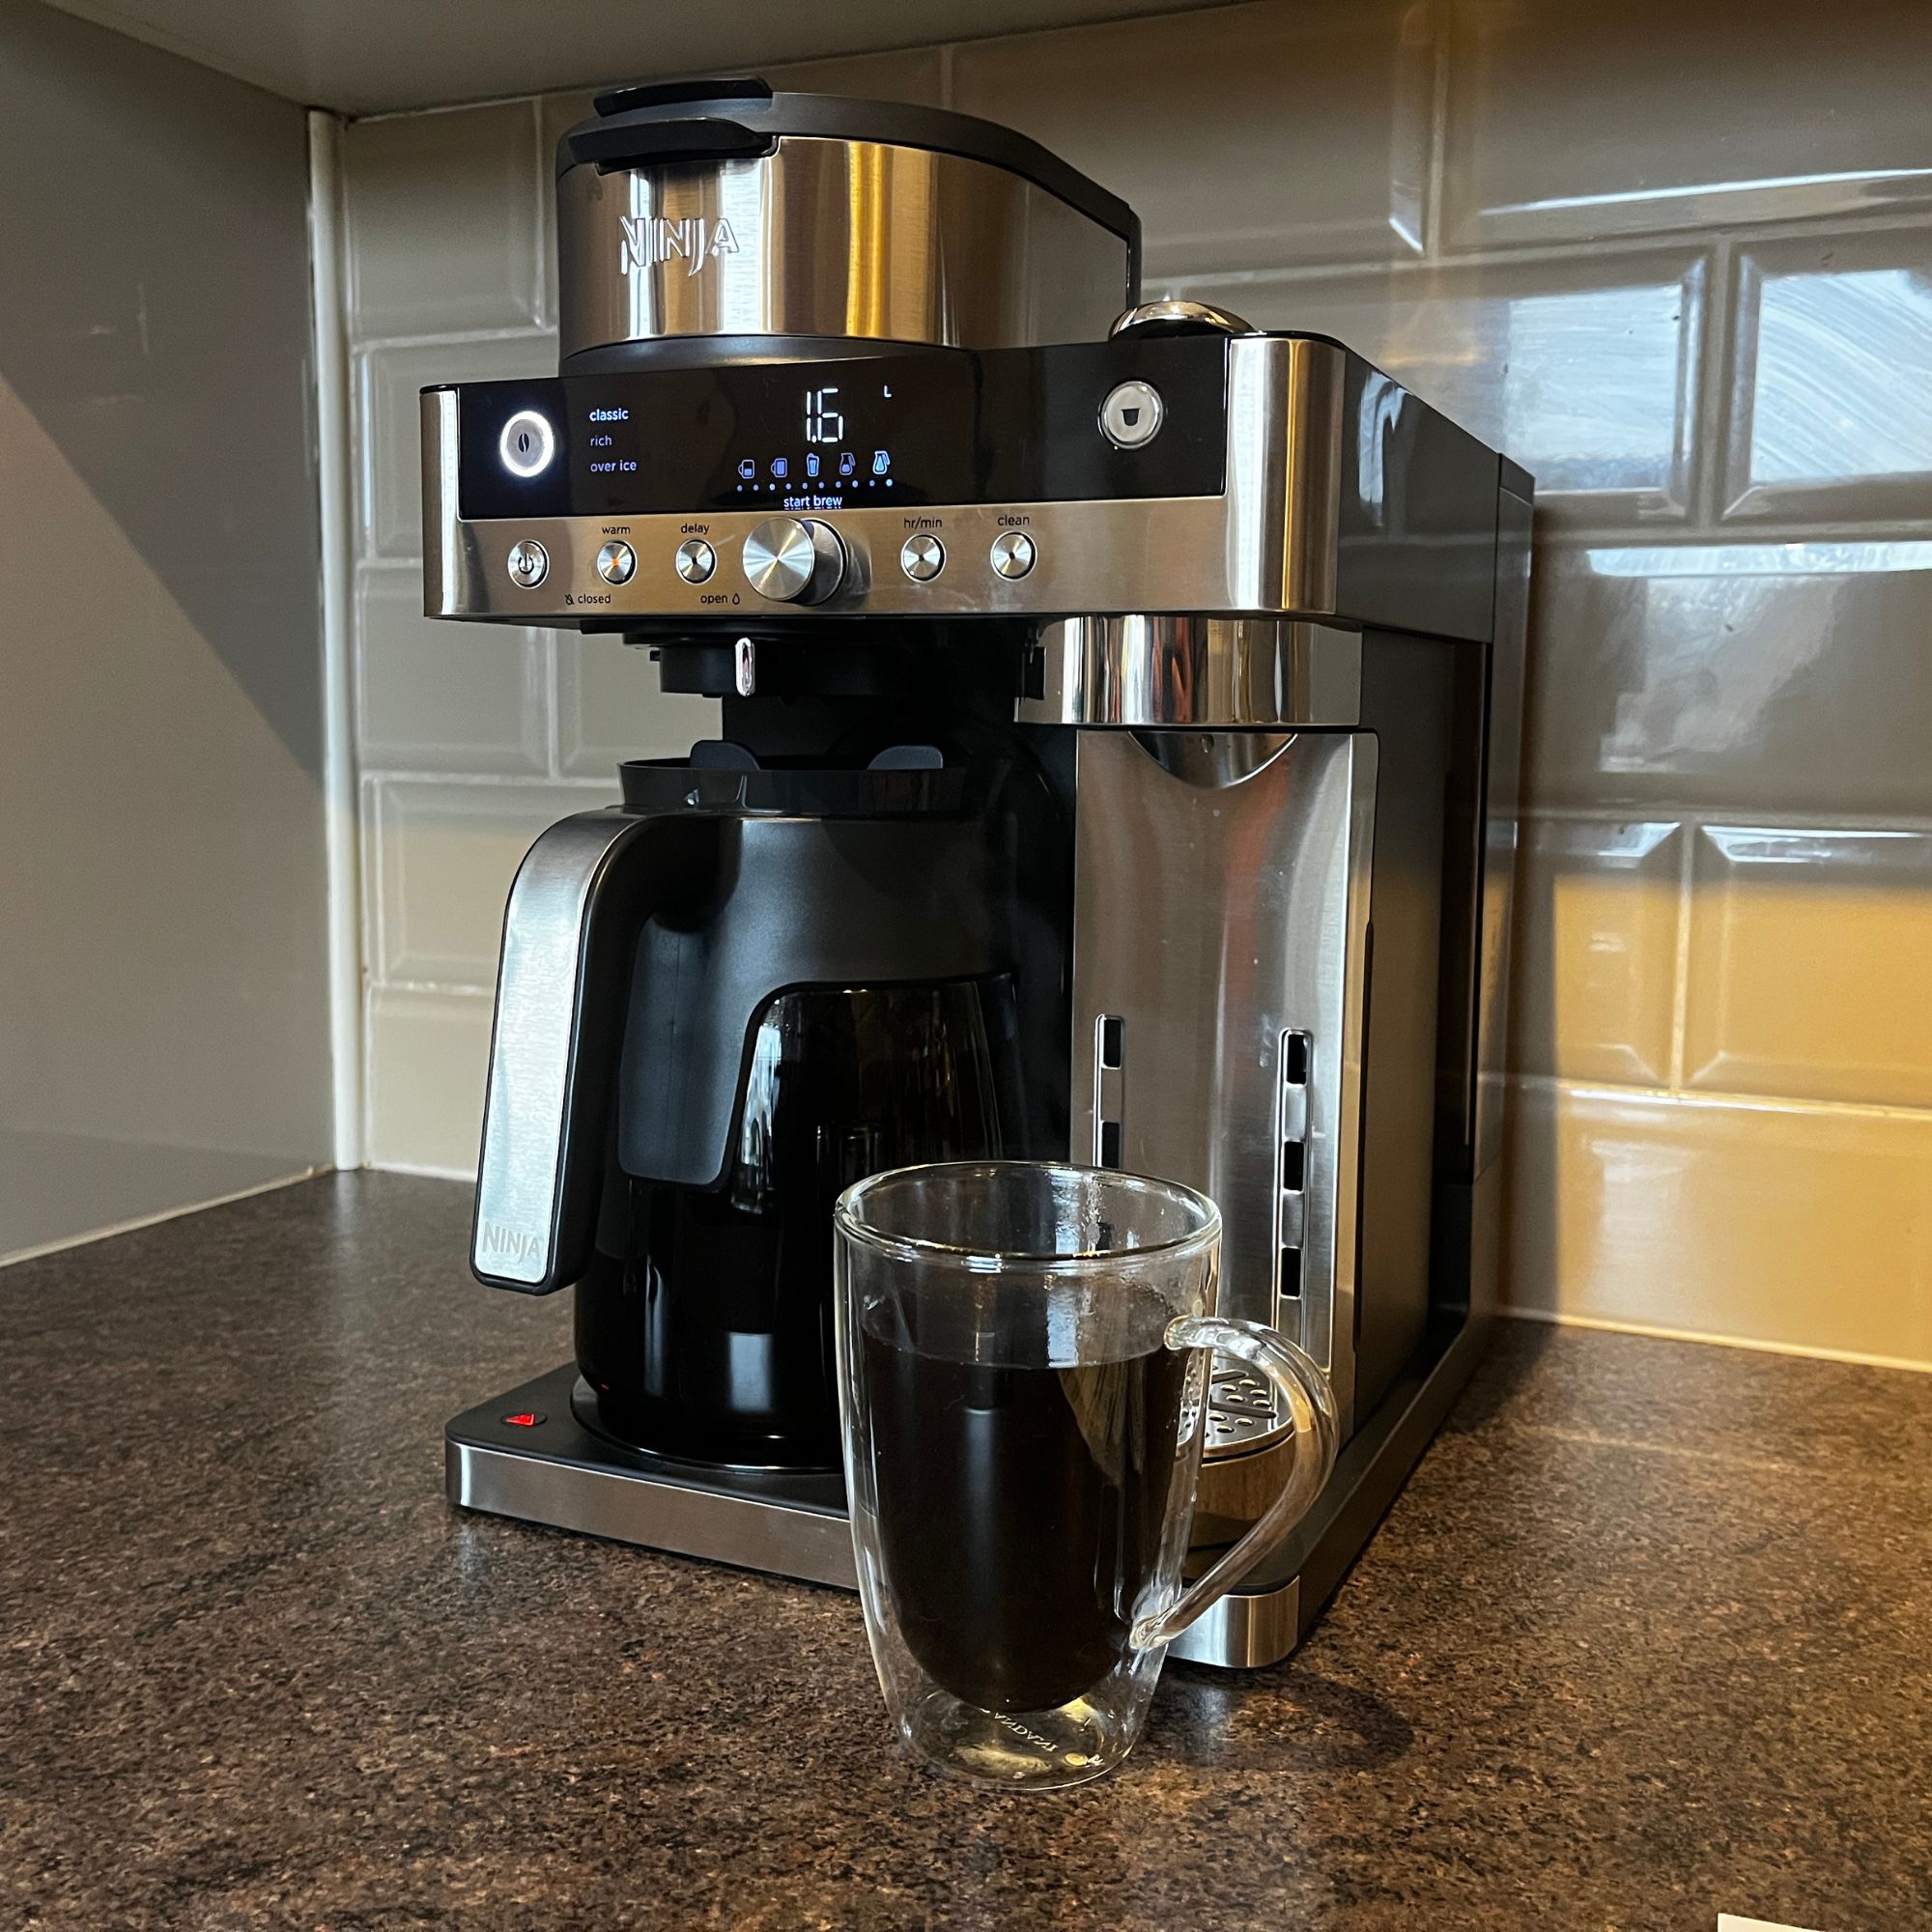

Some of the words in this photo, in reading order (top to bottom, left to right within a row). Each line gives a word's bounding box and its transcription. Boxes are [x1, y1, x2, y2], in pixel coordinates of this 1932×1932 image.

[618, 216, 740, 277] NINJA
[588, 407, 629, 422] classic
[806, 387, 844, 443] 1.6
[589, 435, 612, 446] rich
[589, 462, 617, 472] over
[619, 459, 638, 471] ice
[782, 495, 810, 508] start
[812, 494, 843, 507] brew
[903, 516, 943, 529] hr/min
[997, 515, 1030, 526] clean
[601, 526, 631, 535] warm
[680, 523, 710, 535] delay
[577, 593, 611, 604] closed
[699, 593, 728, 605] open
[482, 1220, 541, 1265] NINJA
